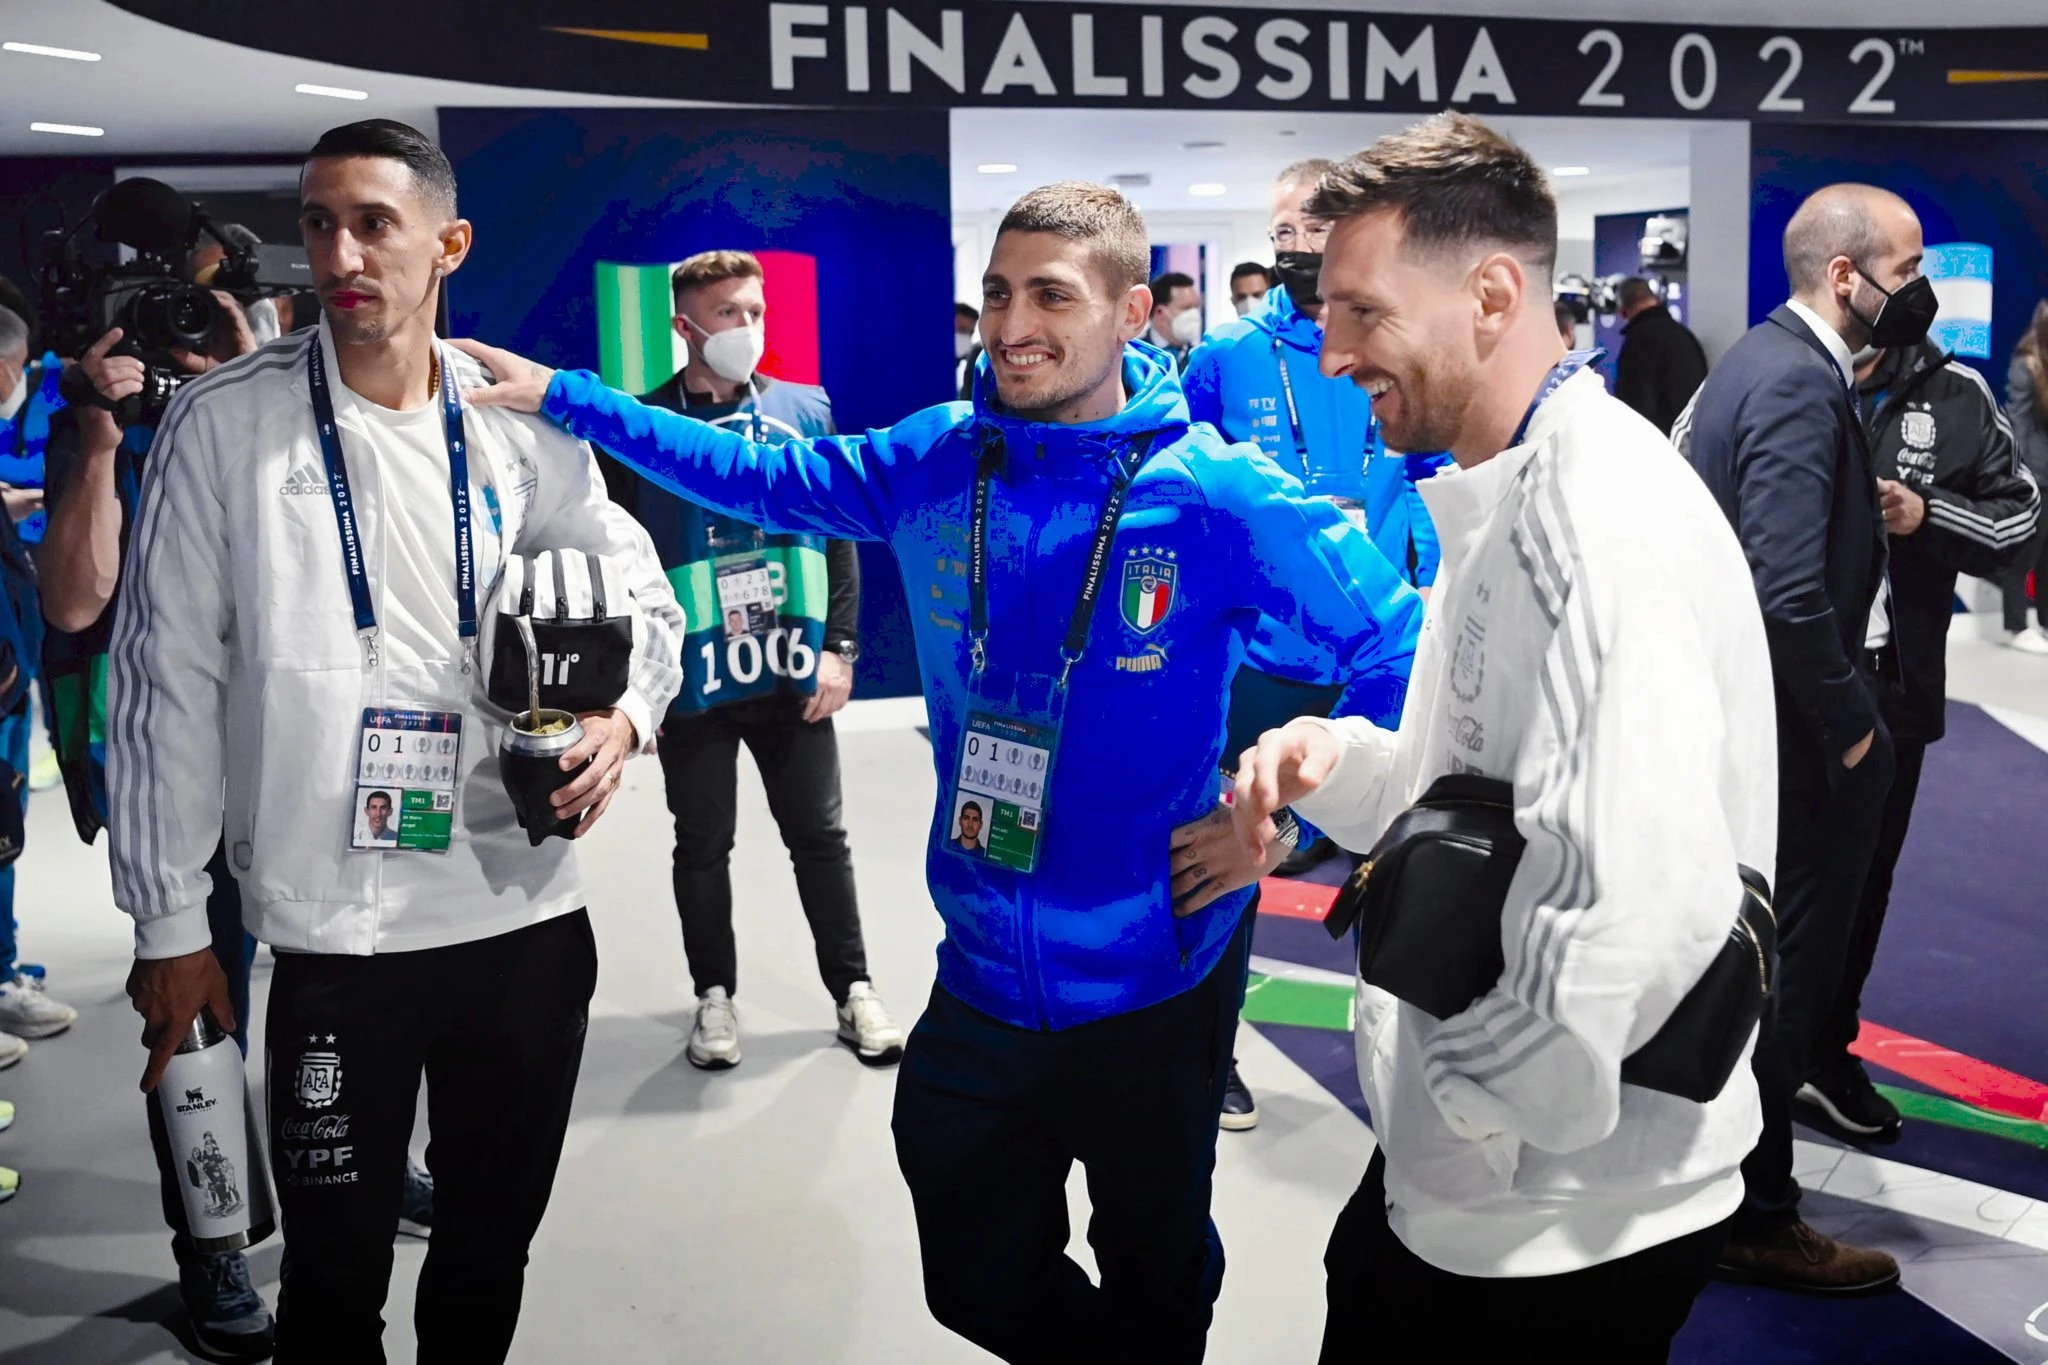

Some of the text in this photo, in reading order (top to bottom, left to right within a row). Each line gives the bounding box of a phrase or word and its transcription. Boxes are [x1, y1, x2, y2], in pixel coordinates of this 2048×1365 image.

[770, 3, 1516, 104] FINALISSIMA
[279, 482, 332, 495] adidas
[334, 473, 360, 575] FINALISSIMA 2022
[974, 480, 985, 583] FINALISSIMA 2022
[458, 488, 470, 589] FINALISSIMA 2022
[1083, 497, 1119, 600] FINALISSIMA 2022
[1128, 564, 1171, 578] ITALIA
[1116, 654, 1162, 672] PUMA
[972, 720, 991, 730] UEFA
[368, 733, 403, 753] 0 1
[968, 737, 998, 761] 0 1
[176, 1098, 217, 1112] STANLEY
[283, 1146, 354, 1169] YPF
[302, 1171, 359, 1186] BINANCE
